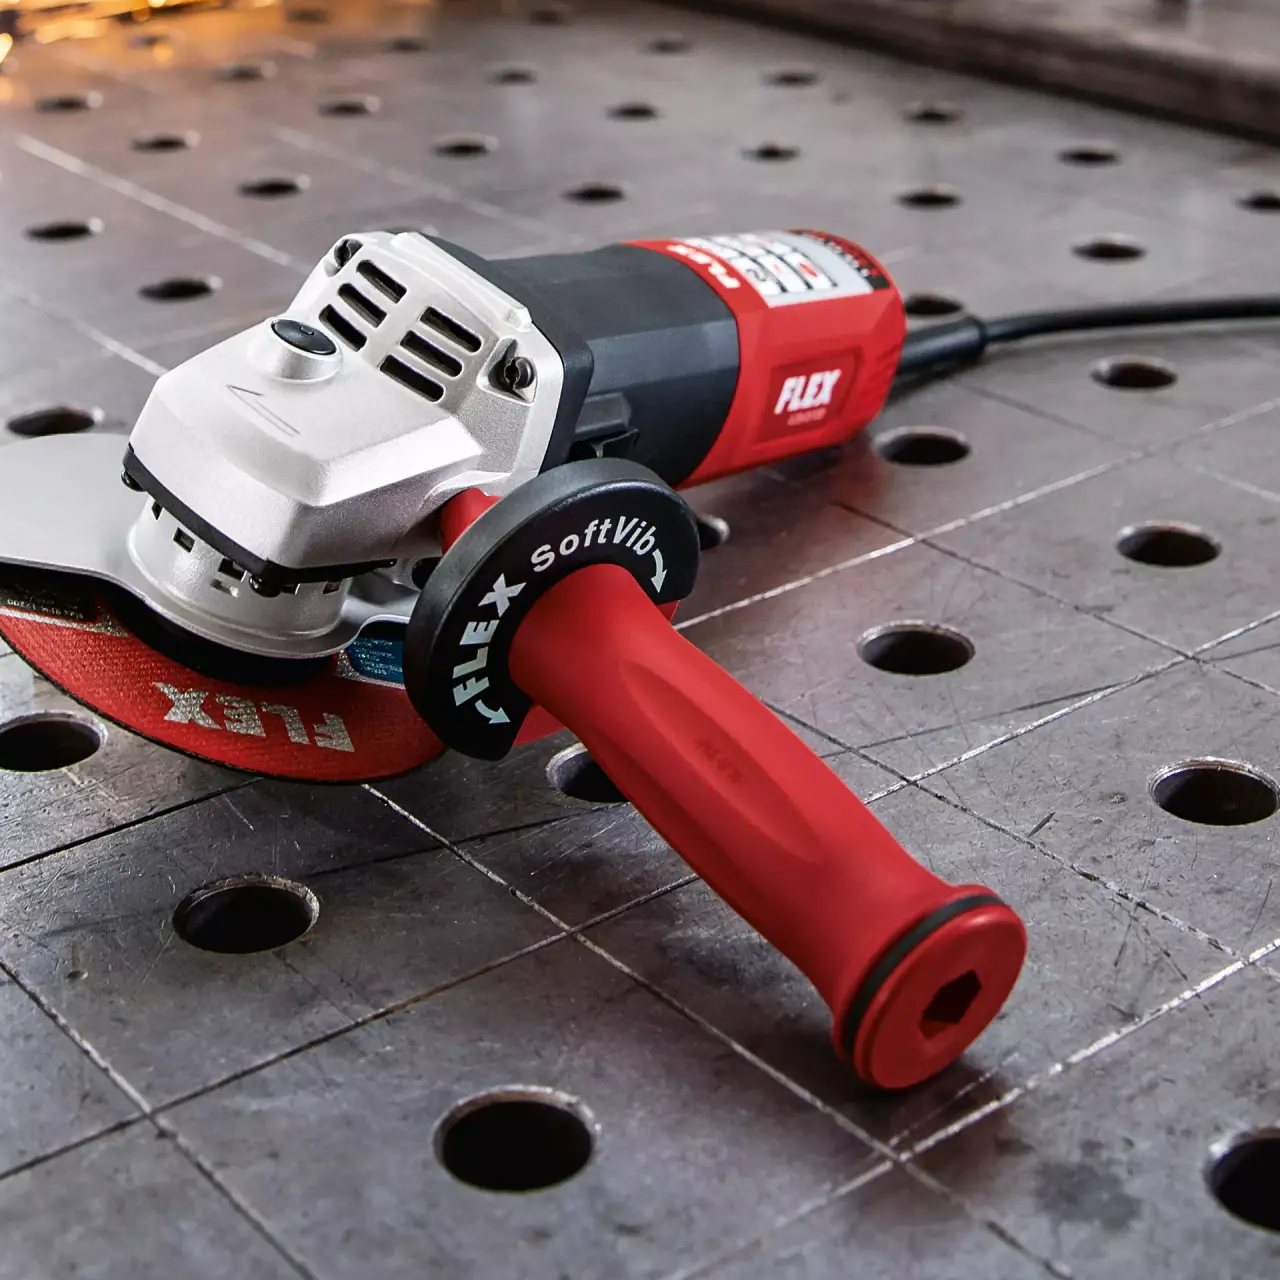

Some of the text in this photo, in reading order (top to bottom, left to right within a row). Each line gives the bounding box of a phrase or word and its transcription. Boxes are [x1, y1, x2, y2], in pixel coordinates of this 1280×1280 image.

[773, 369, 842, 415] FLEX
[452, 573, 527, 707] FLEX
[530, 516, 656, 572] SoftVib
[152, 682, 355, 753] FLEX
